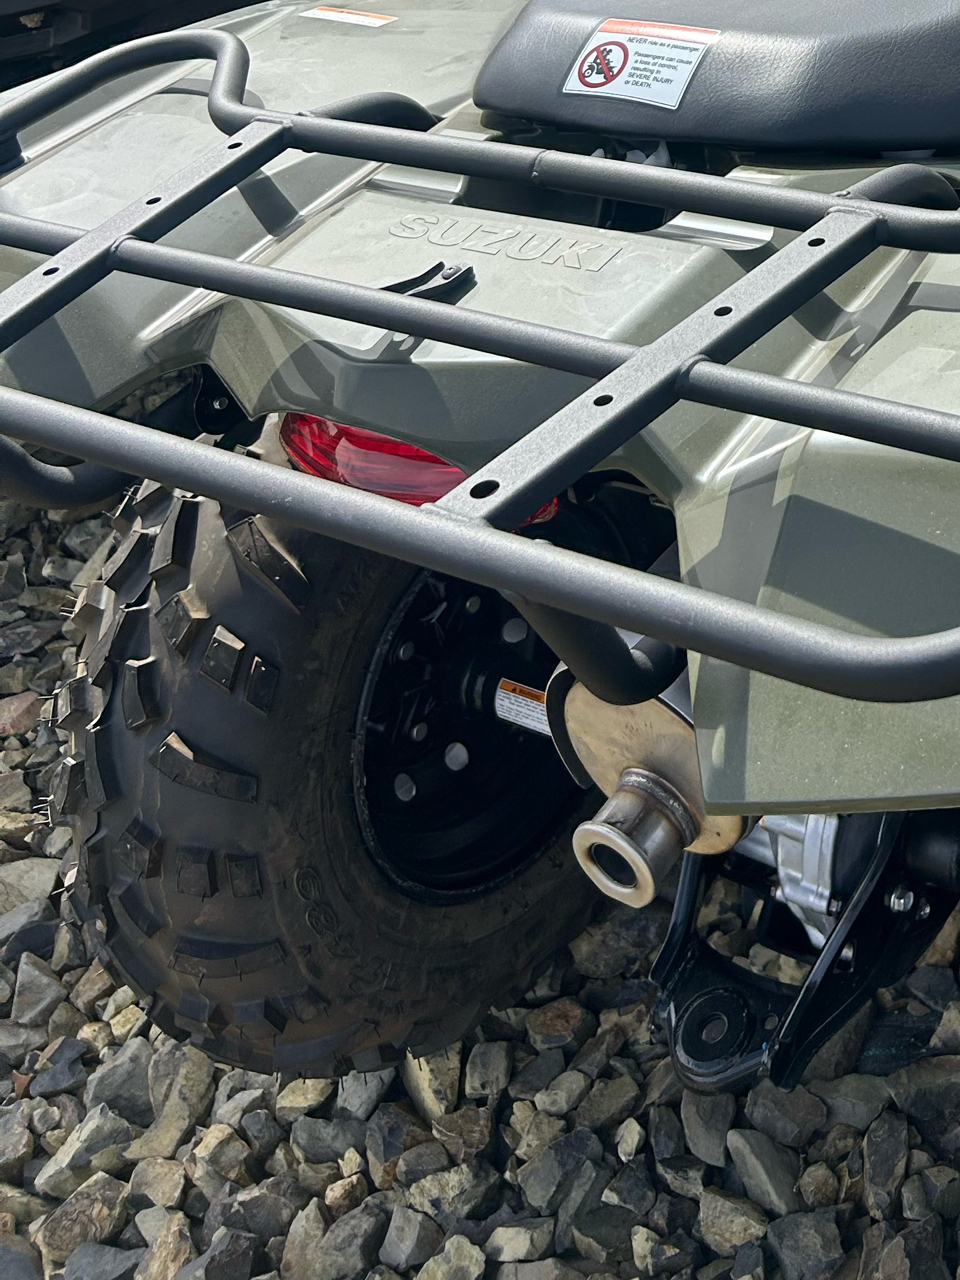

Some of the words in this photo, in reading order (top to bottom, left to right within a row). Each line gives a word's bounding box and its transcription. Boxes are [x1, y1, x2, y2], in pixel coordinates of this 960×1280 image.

[670, 44, 700, 53] passenger.
[634, 51, 665, 60] Passengers
[631, 66, 655, 75] resulting
[628, 72, 651, 81] SEVERE
[652, 76, 674, 85] INJURY
[389, 213, 623, 273] SUZUKI
